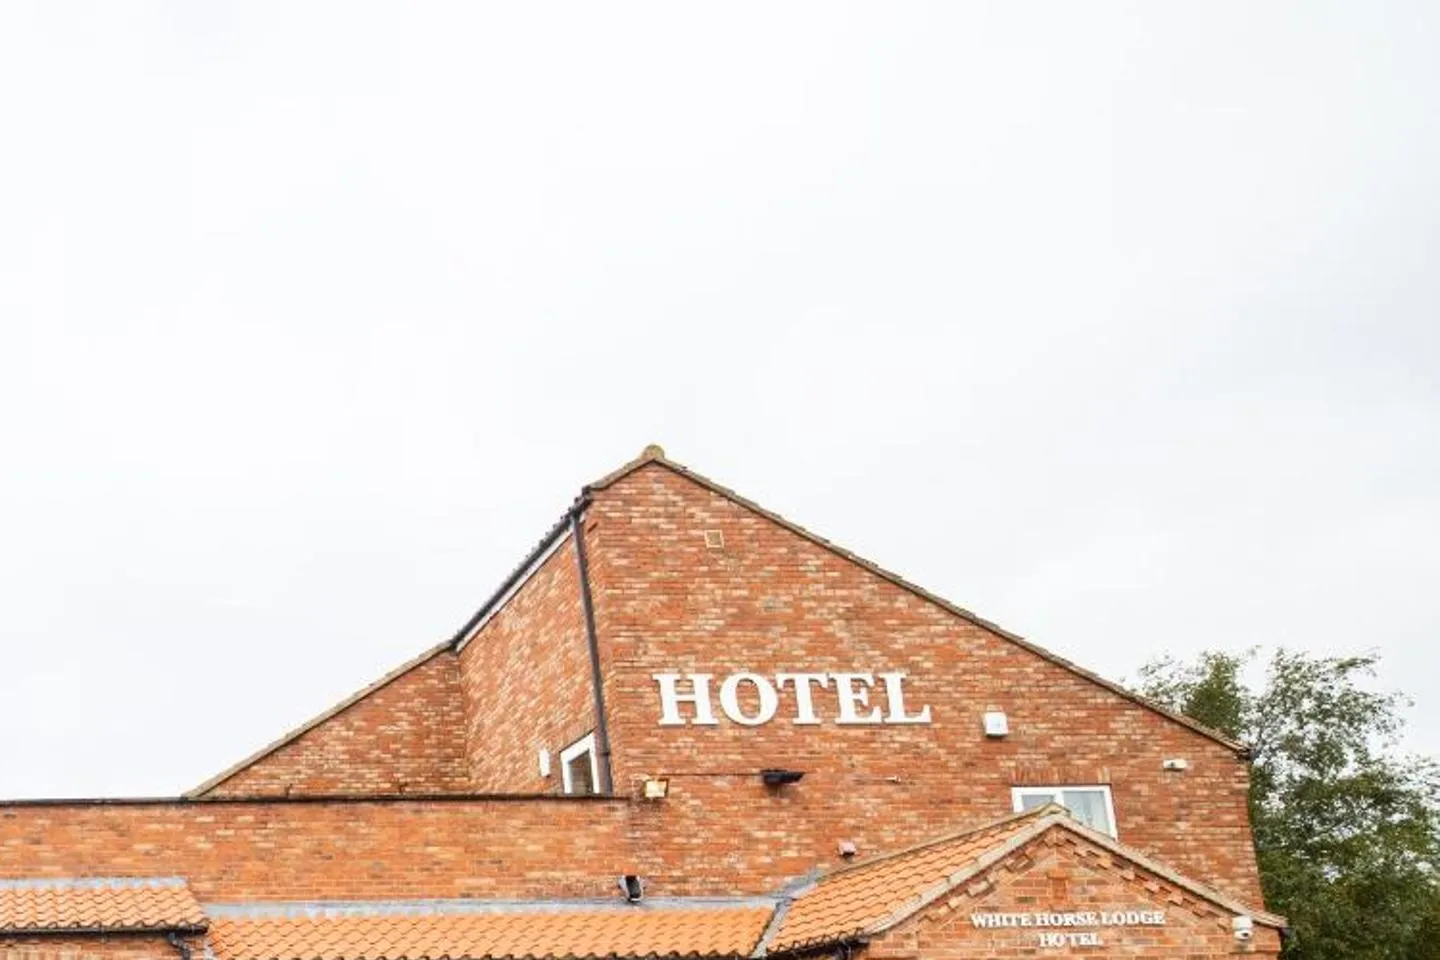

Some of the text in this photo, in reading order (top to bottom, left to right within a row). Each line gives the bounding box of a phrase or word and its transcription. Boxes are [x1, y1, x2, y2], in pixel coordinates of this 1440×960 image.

[653, 672, 932, 726] HOTEL
[971, 910, 1166, 928] WHITE HORSE LODGE
[1040, 932, 1103, 947] HOTEL
